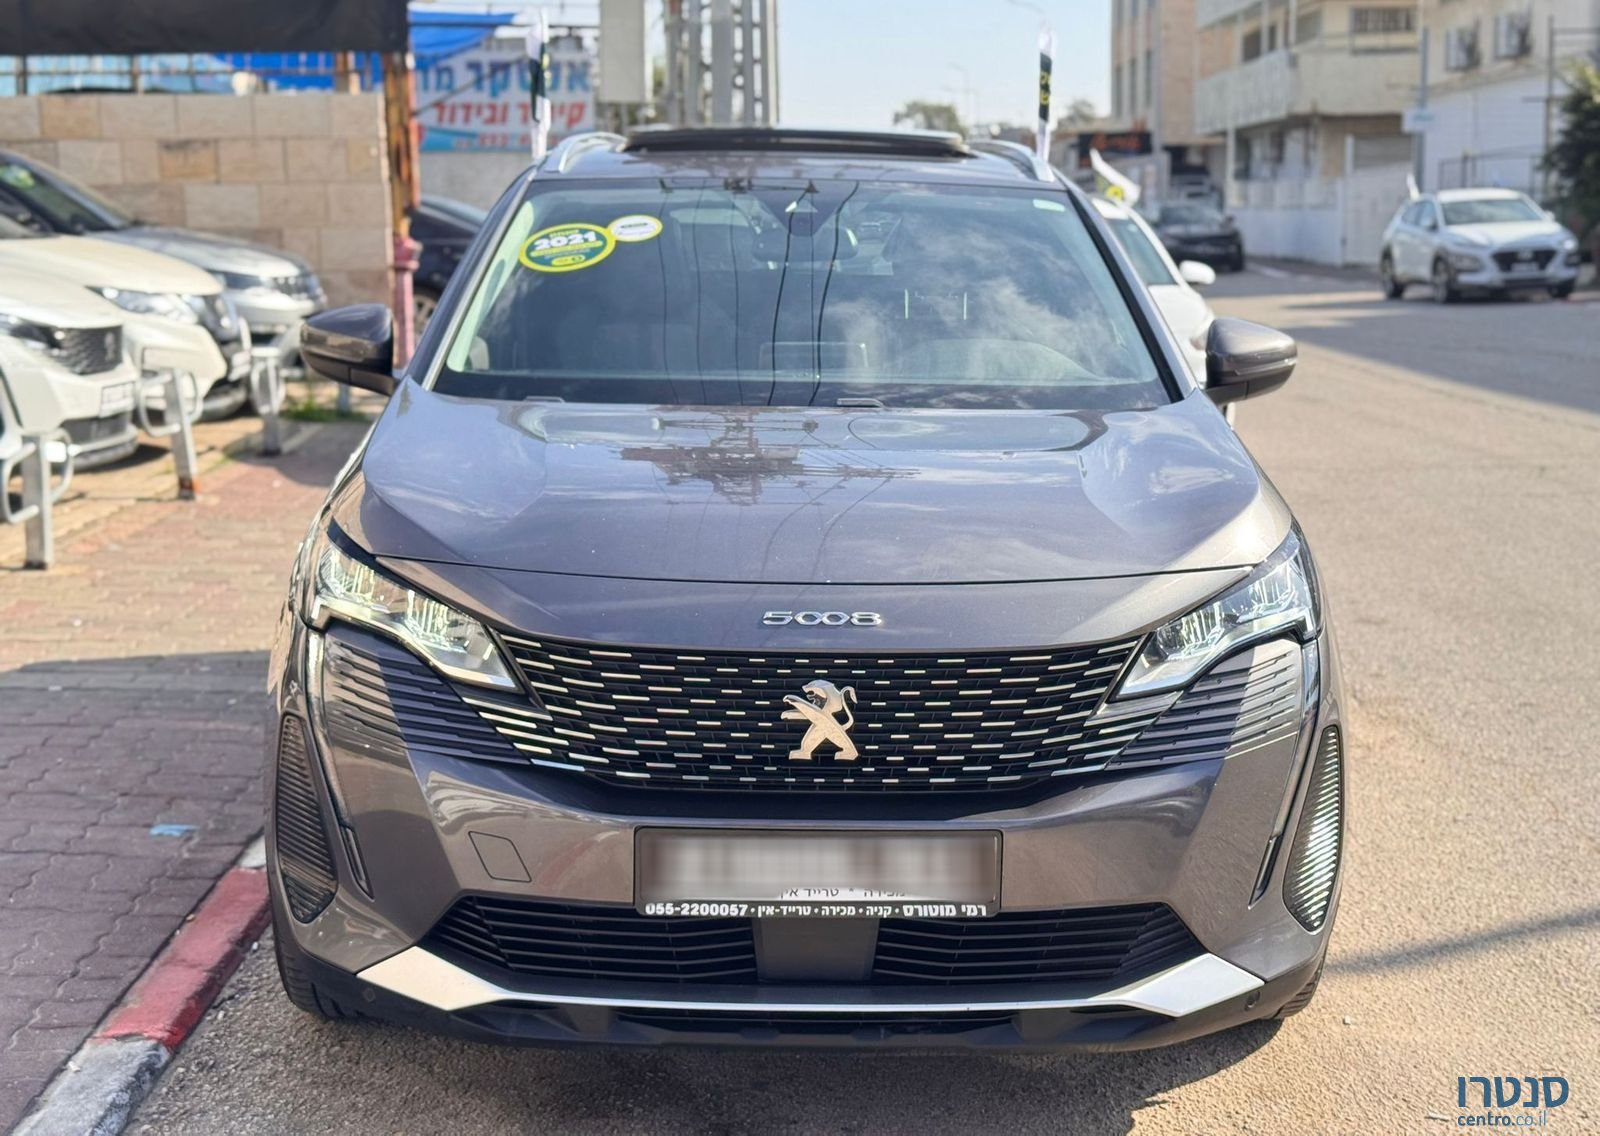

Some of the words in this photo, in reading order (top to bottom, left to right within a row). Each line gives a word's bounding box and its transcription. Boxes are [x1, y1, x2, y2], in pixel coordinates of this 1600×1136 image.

[534, 231, 597, 251] 2021
[762, 610, 883, 626] 5008
[645, 903, 748, 916] 055-2200057
[757, 905, 811, 917] טרייד-אין
[821, 905, 856, 916] מכירה
[866, 905, 892, 918] קניה
[902, 904, 957, 917] מוטורס
[961, 904, 987, 917] רמי
